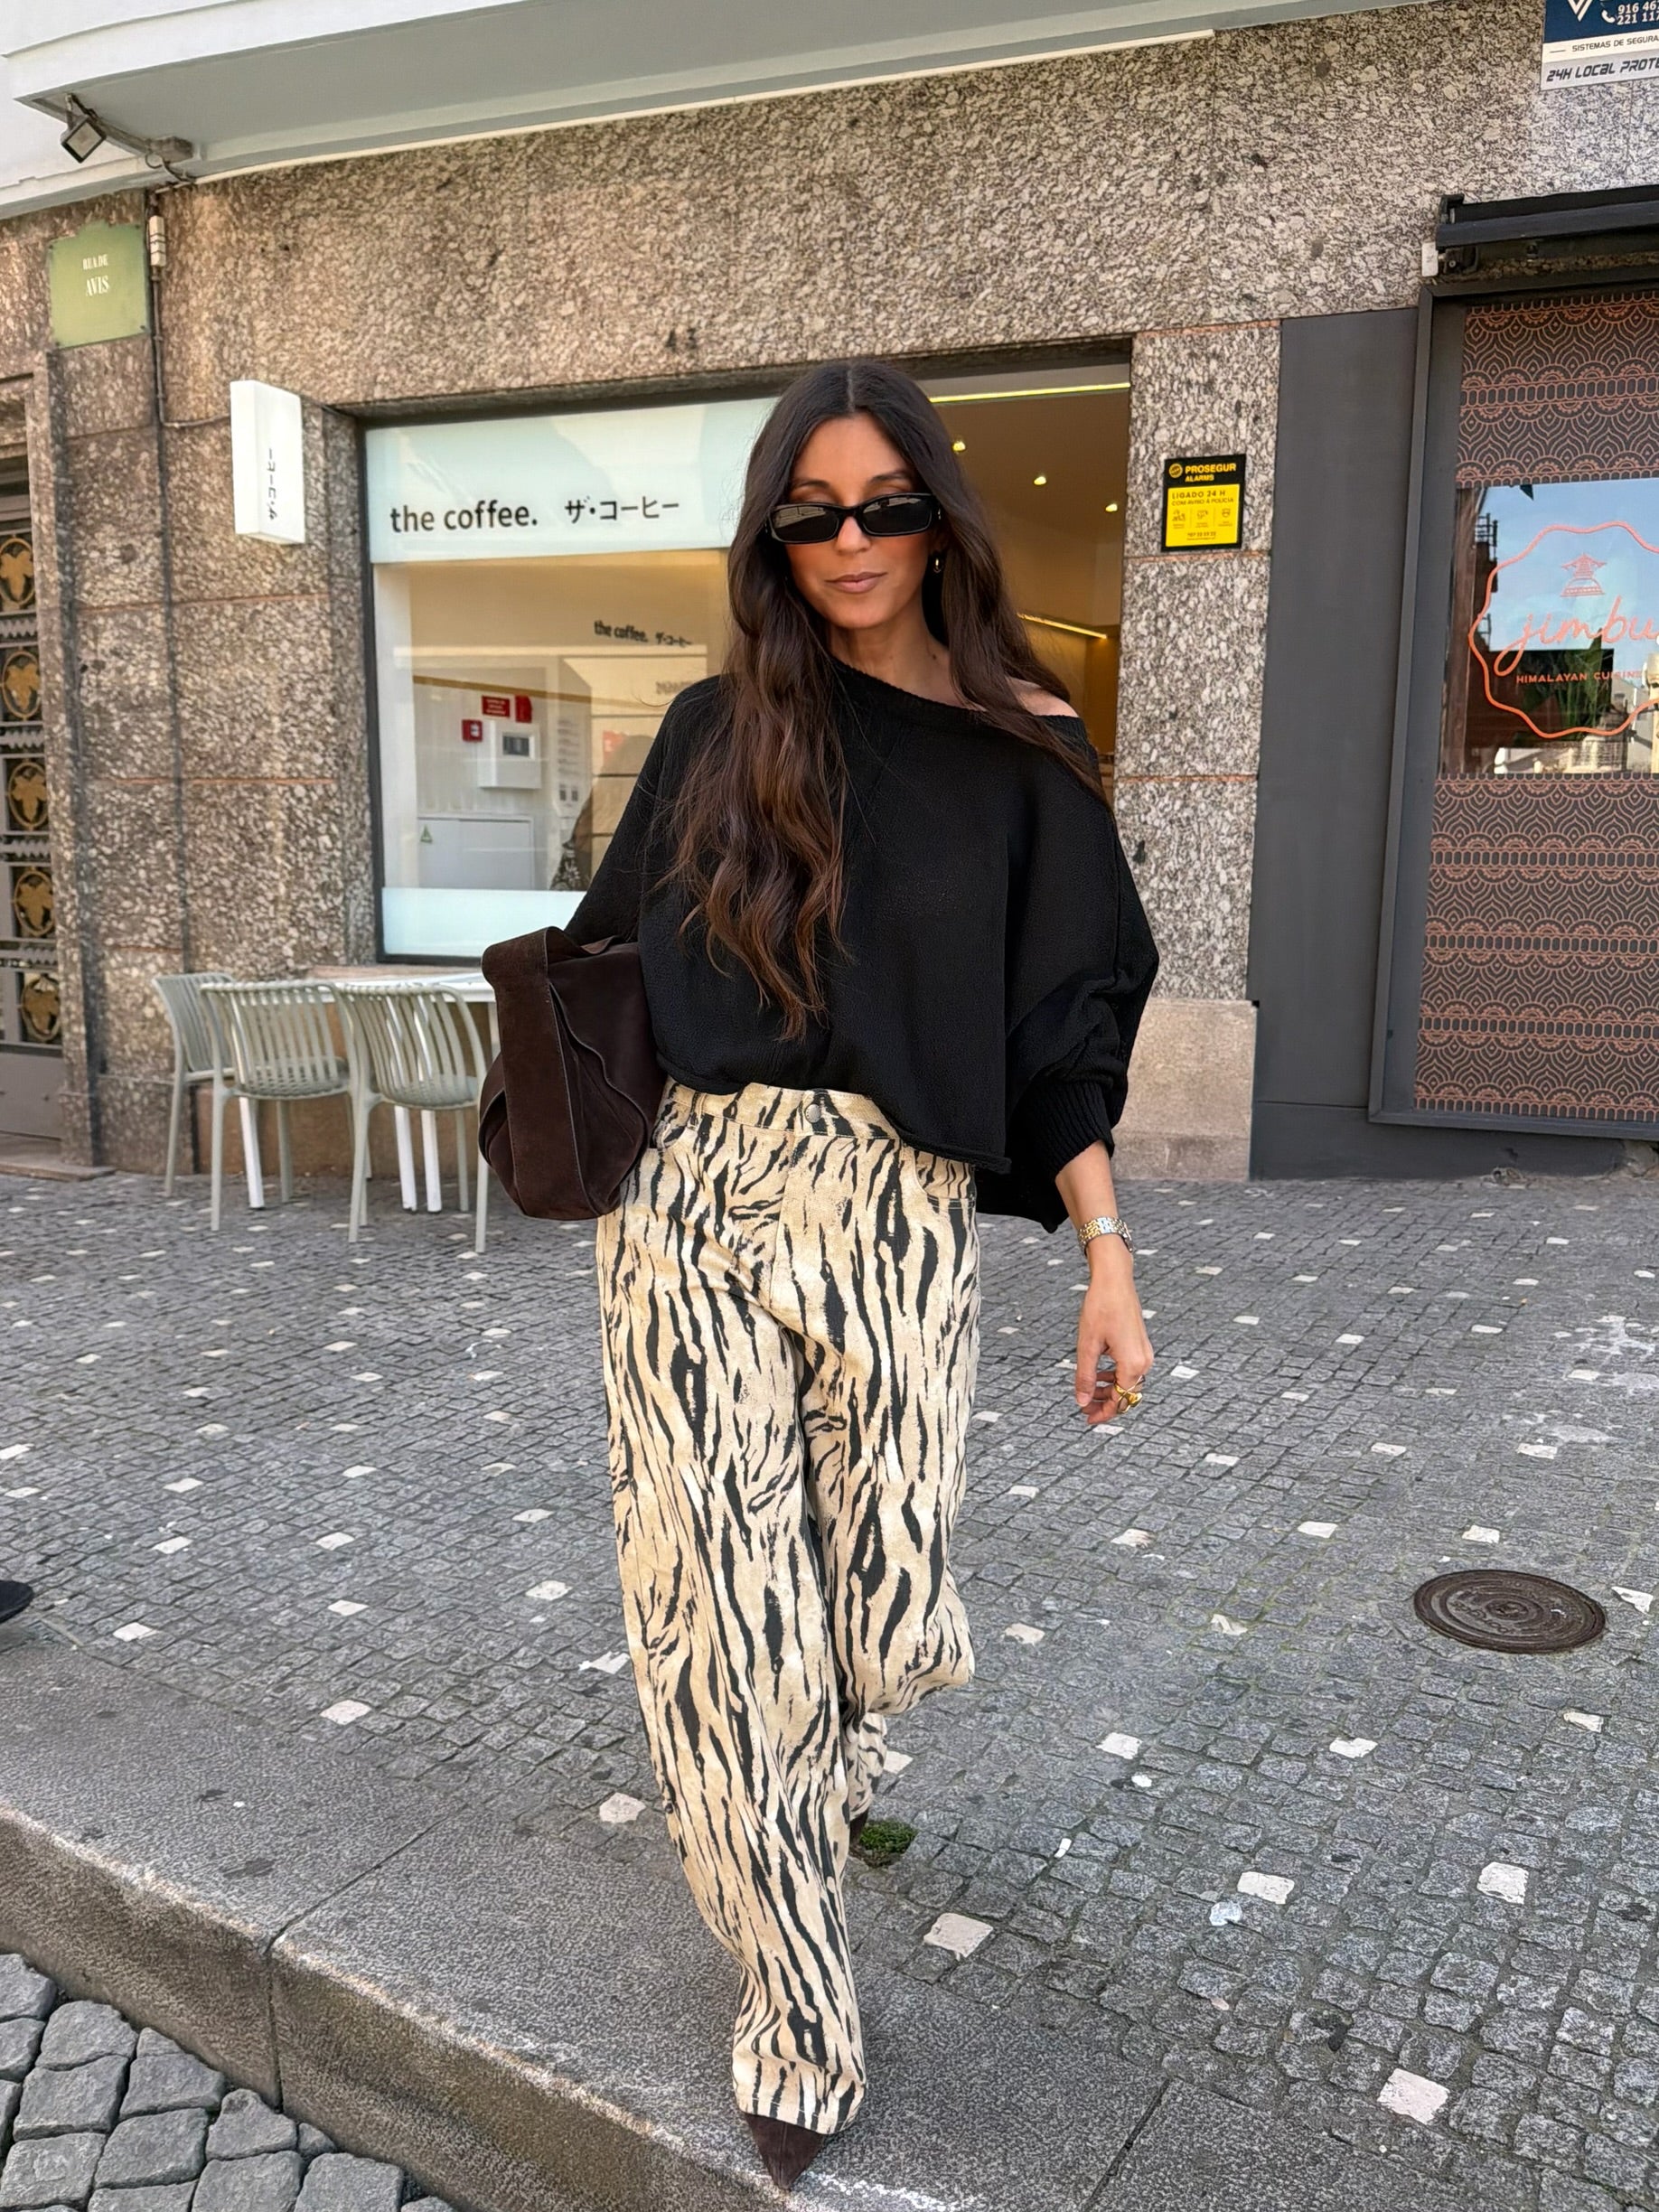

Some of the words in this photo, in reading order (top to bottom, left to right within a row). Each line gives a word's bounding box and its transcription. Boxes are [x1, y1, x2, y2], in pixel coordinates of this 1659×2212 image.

[1617, 3, 1639, 14] 916
[1642, 0, 1659, 11] 46
[1617, 13, 1637, 25] 221
[1572, 41, 1611, 52] SISTEMAS
[1614, 39, 1624, 47] DE
[1547, 68, 1572, 81] 24H
[98, 253, 108, 267] DE
[86, 275, 109, 296] AVIS
[1186, 464, 1236, 473] PROSEGUR
[390, 505, 435, 533] the
[444, 499, 539, 530] coffee.
[565, 495, 680, 524] ザ・コーヒー
[594, 620, 612, 637] the
[1494, 596, 1659, 676] jimbu
[1516, 673, 1588, 684] HIMALAYAN
